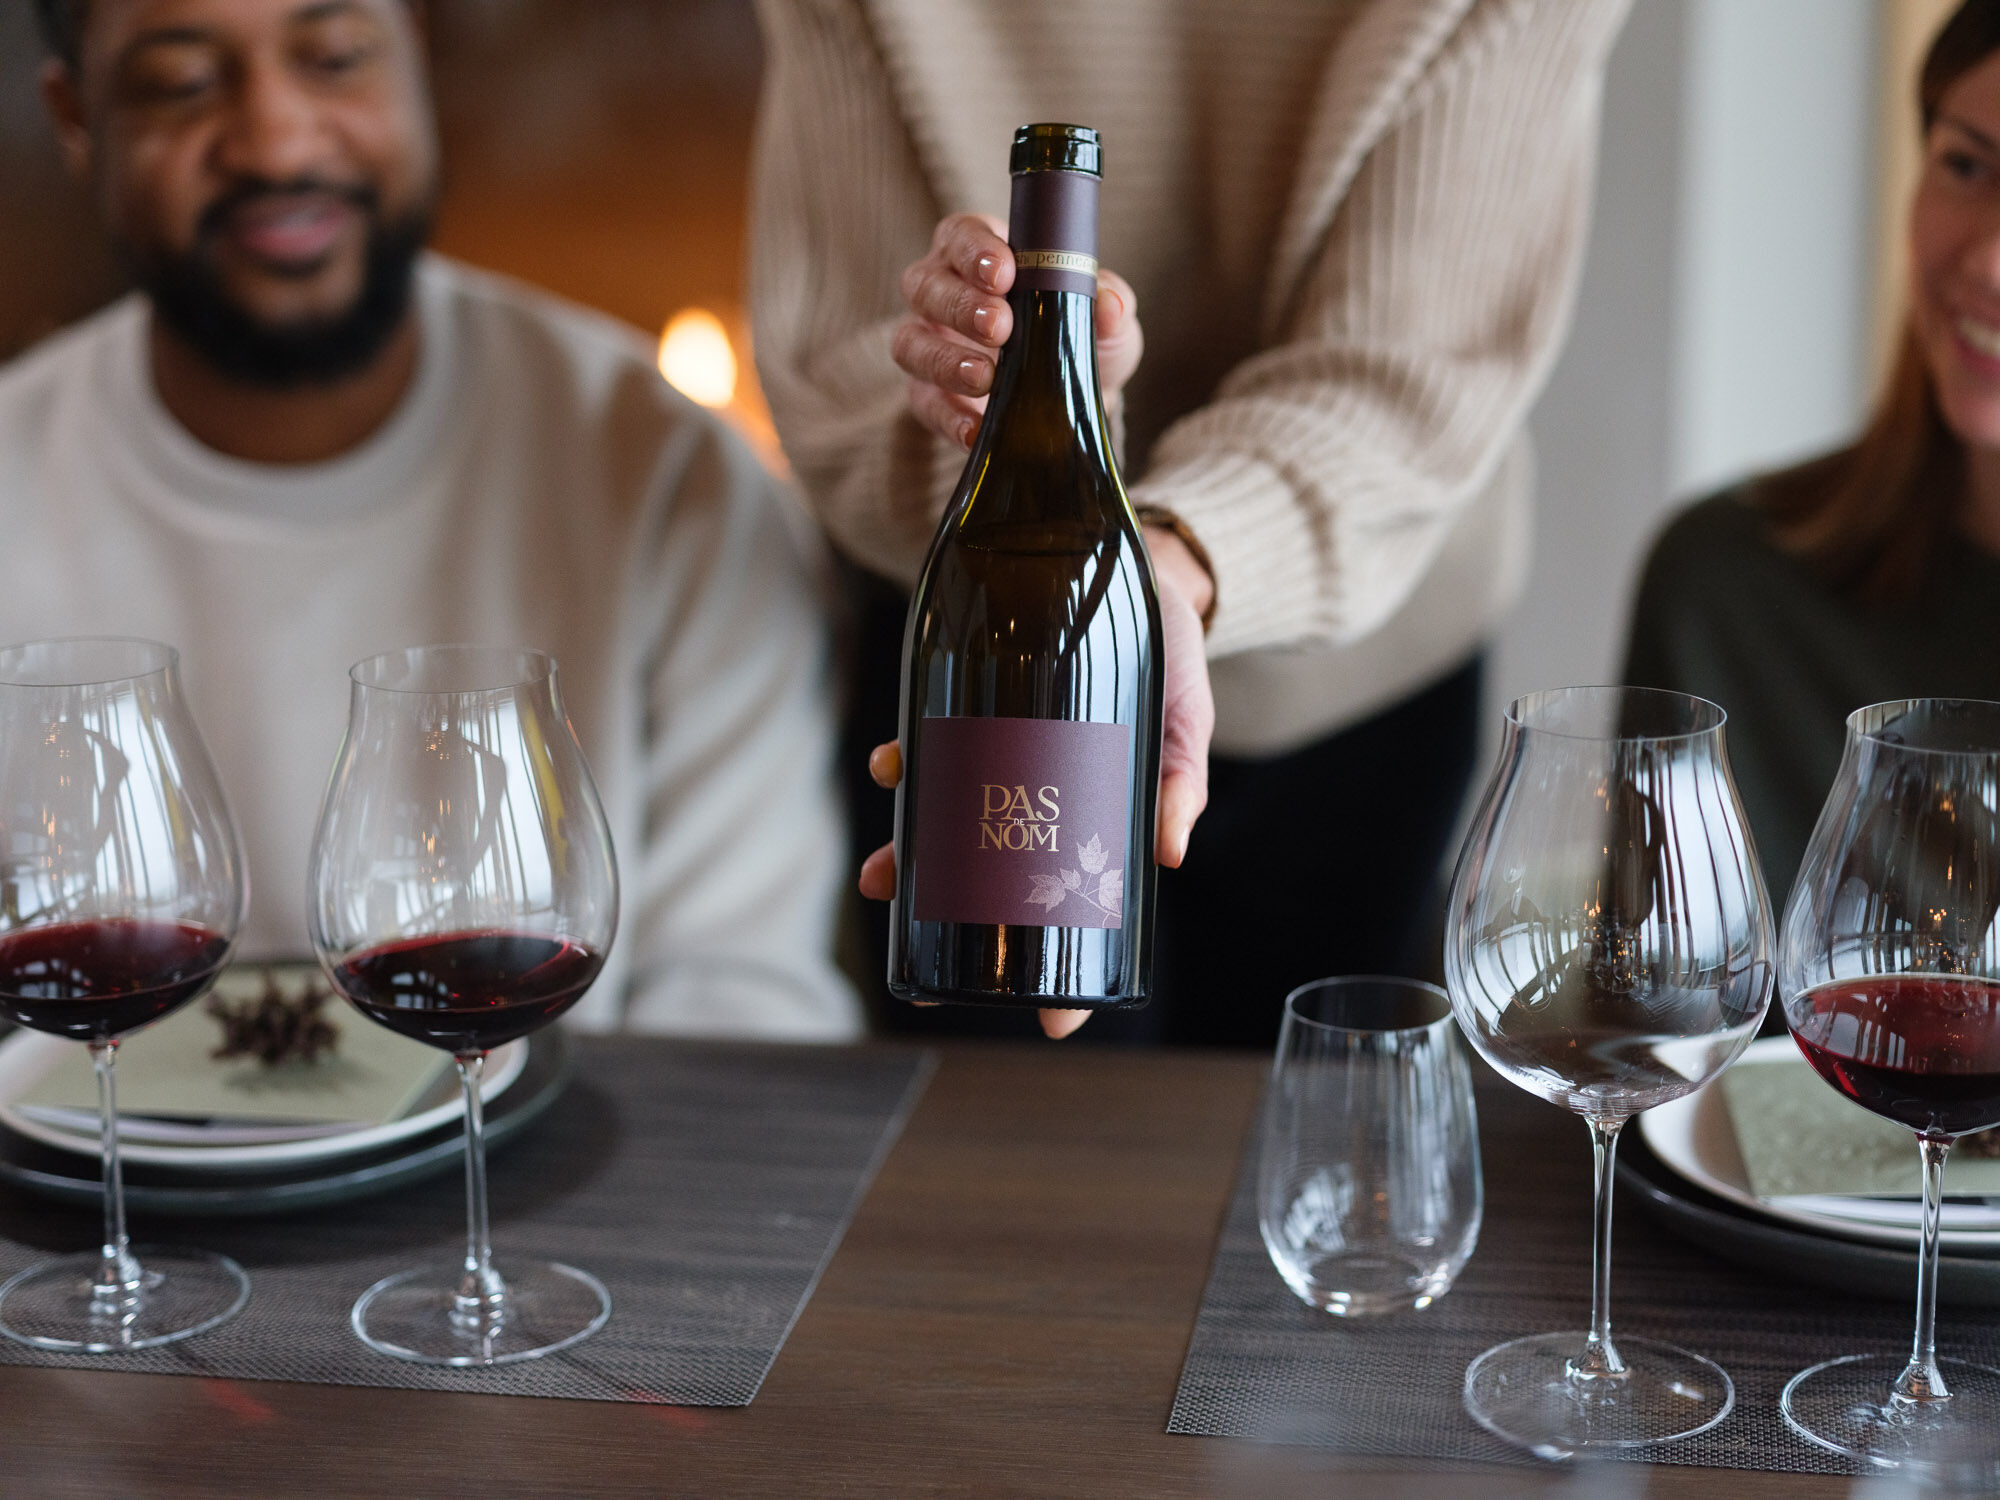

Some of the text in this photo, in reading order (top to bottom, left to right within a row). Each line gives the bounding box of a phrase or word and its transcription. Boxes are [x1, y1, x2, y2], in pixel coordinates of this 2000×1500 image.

[979, 784, 1060, 822] PAS
[1013, 817, 1026, 826] DE
[977, 822, 1061, 852] NOM
